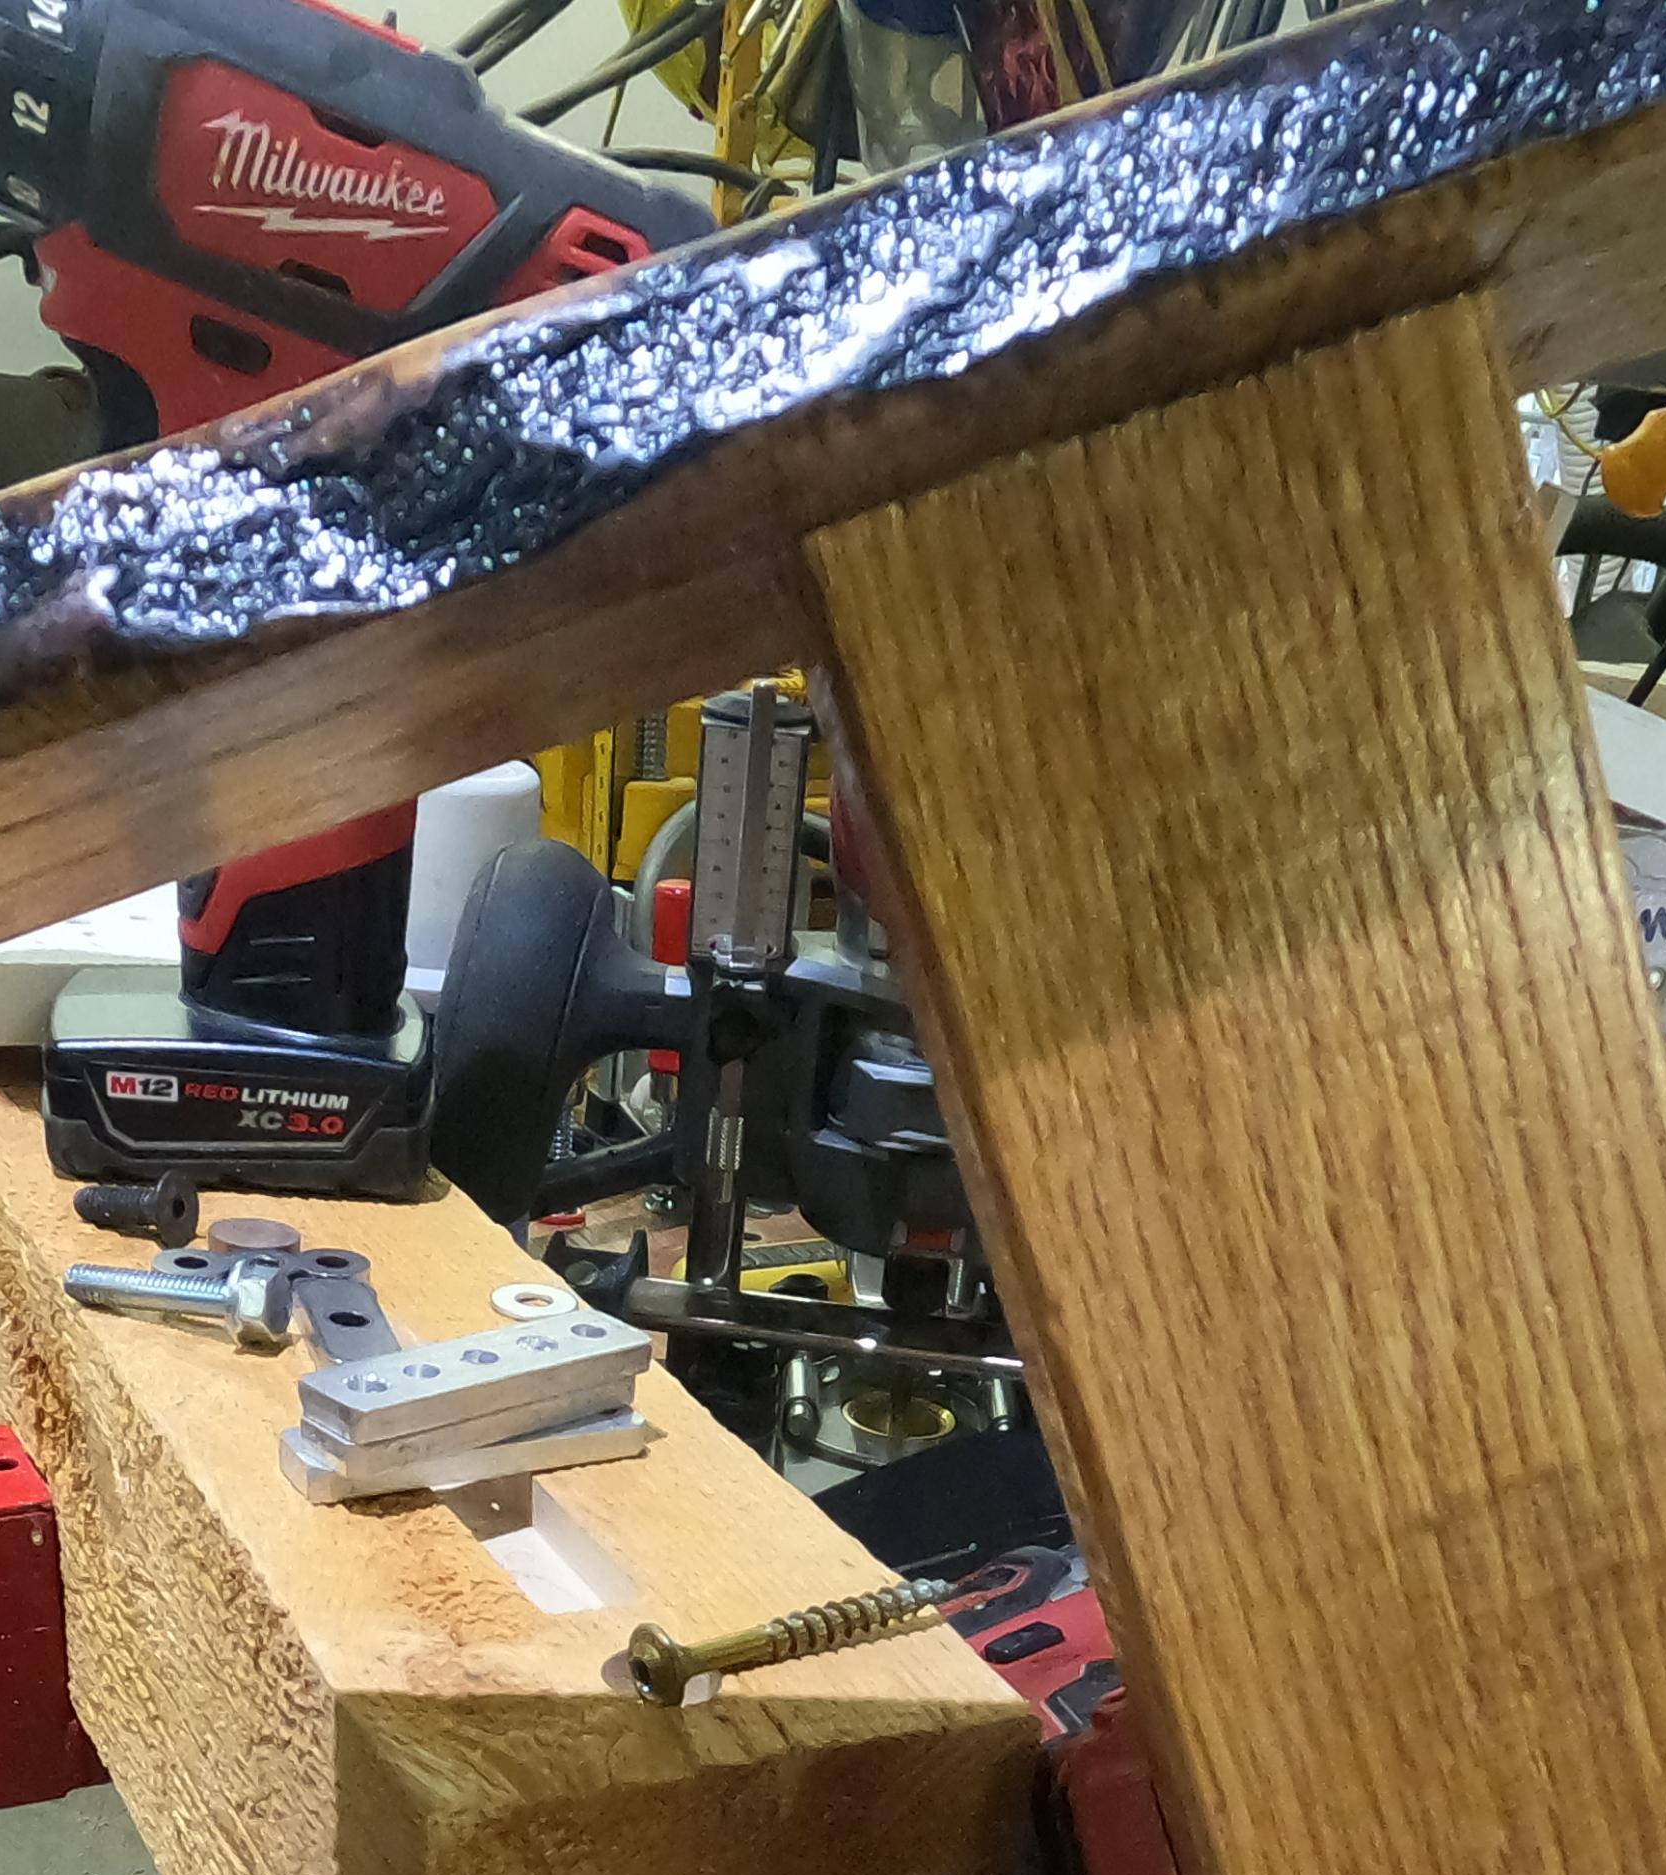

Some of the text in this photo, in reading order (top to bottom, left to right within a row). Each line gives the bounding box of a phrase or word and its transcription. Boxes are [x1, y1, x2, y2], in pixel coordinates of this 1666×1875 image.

[11, 90, 50, 134] 12
[201, 109, 445, 216] Milwaukee
[110, 1075, 174, 1098] M12
